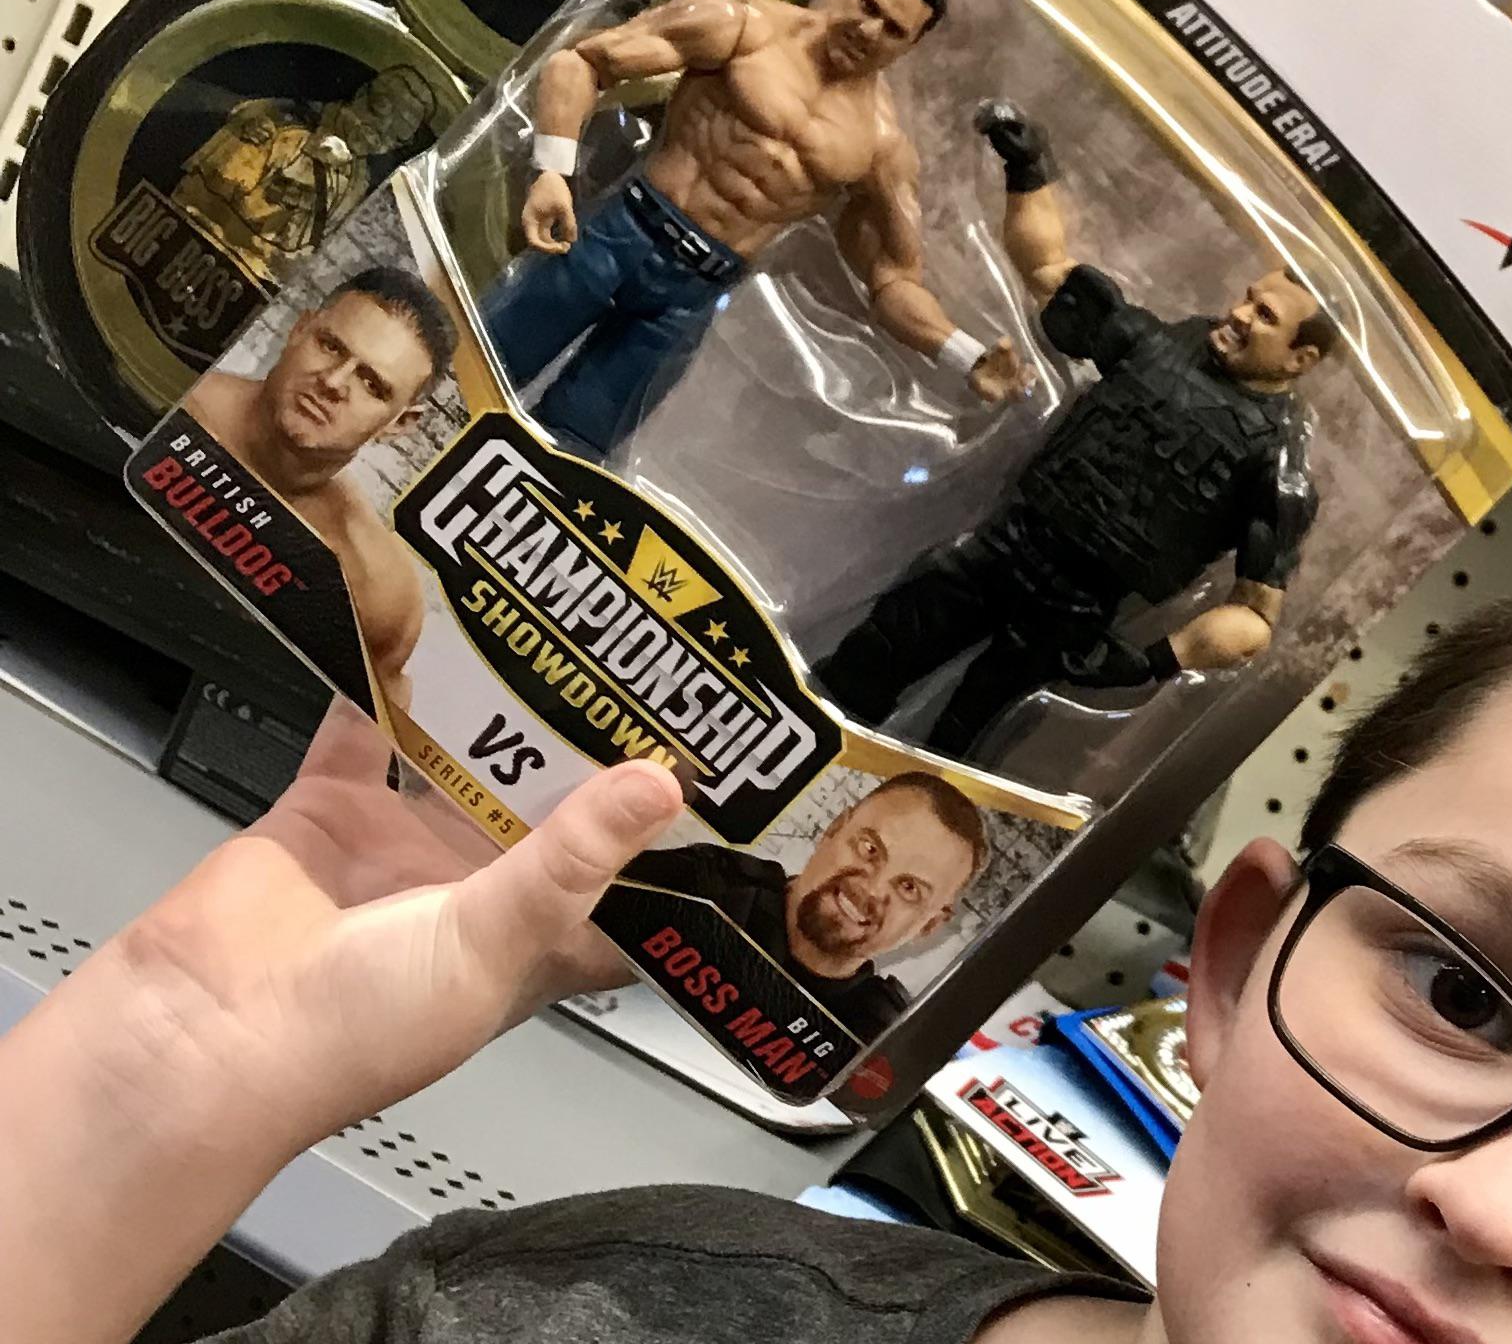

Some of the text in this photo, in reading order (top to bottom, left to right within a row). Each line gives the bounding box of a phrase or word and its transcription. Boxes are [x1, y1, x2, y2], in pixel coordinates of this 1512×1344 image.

[1166, 0, 1342, 173] ATTITUDE ERA!
[141, 455, 292, 597] BULLDOG
[169, 432, 272, 531] BRITISH
[419, 438, 817, 808] CHAMPIONSHIP
[459, 578, 678, 773] SHOWDOWN
[417, 743, 515, 836] SERIES #5
[467, 712, 546, 787] VS
[640, 925, 741, 1015] BOSS
[723, 1007, 813, 1086] MAN
[786, 1015, 836, 1060] BIG
[971, 1093, 1093, 1190] ACTION
[1005, 1097, 1087, 1168] LIVE
